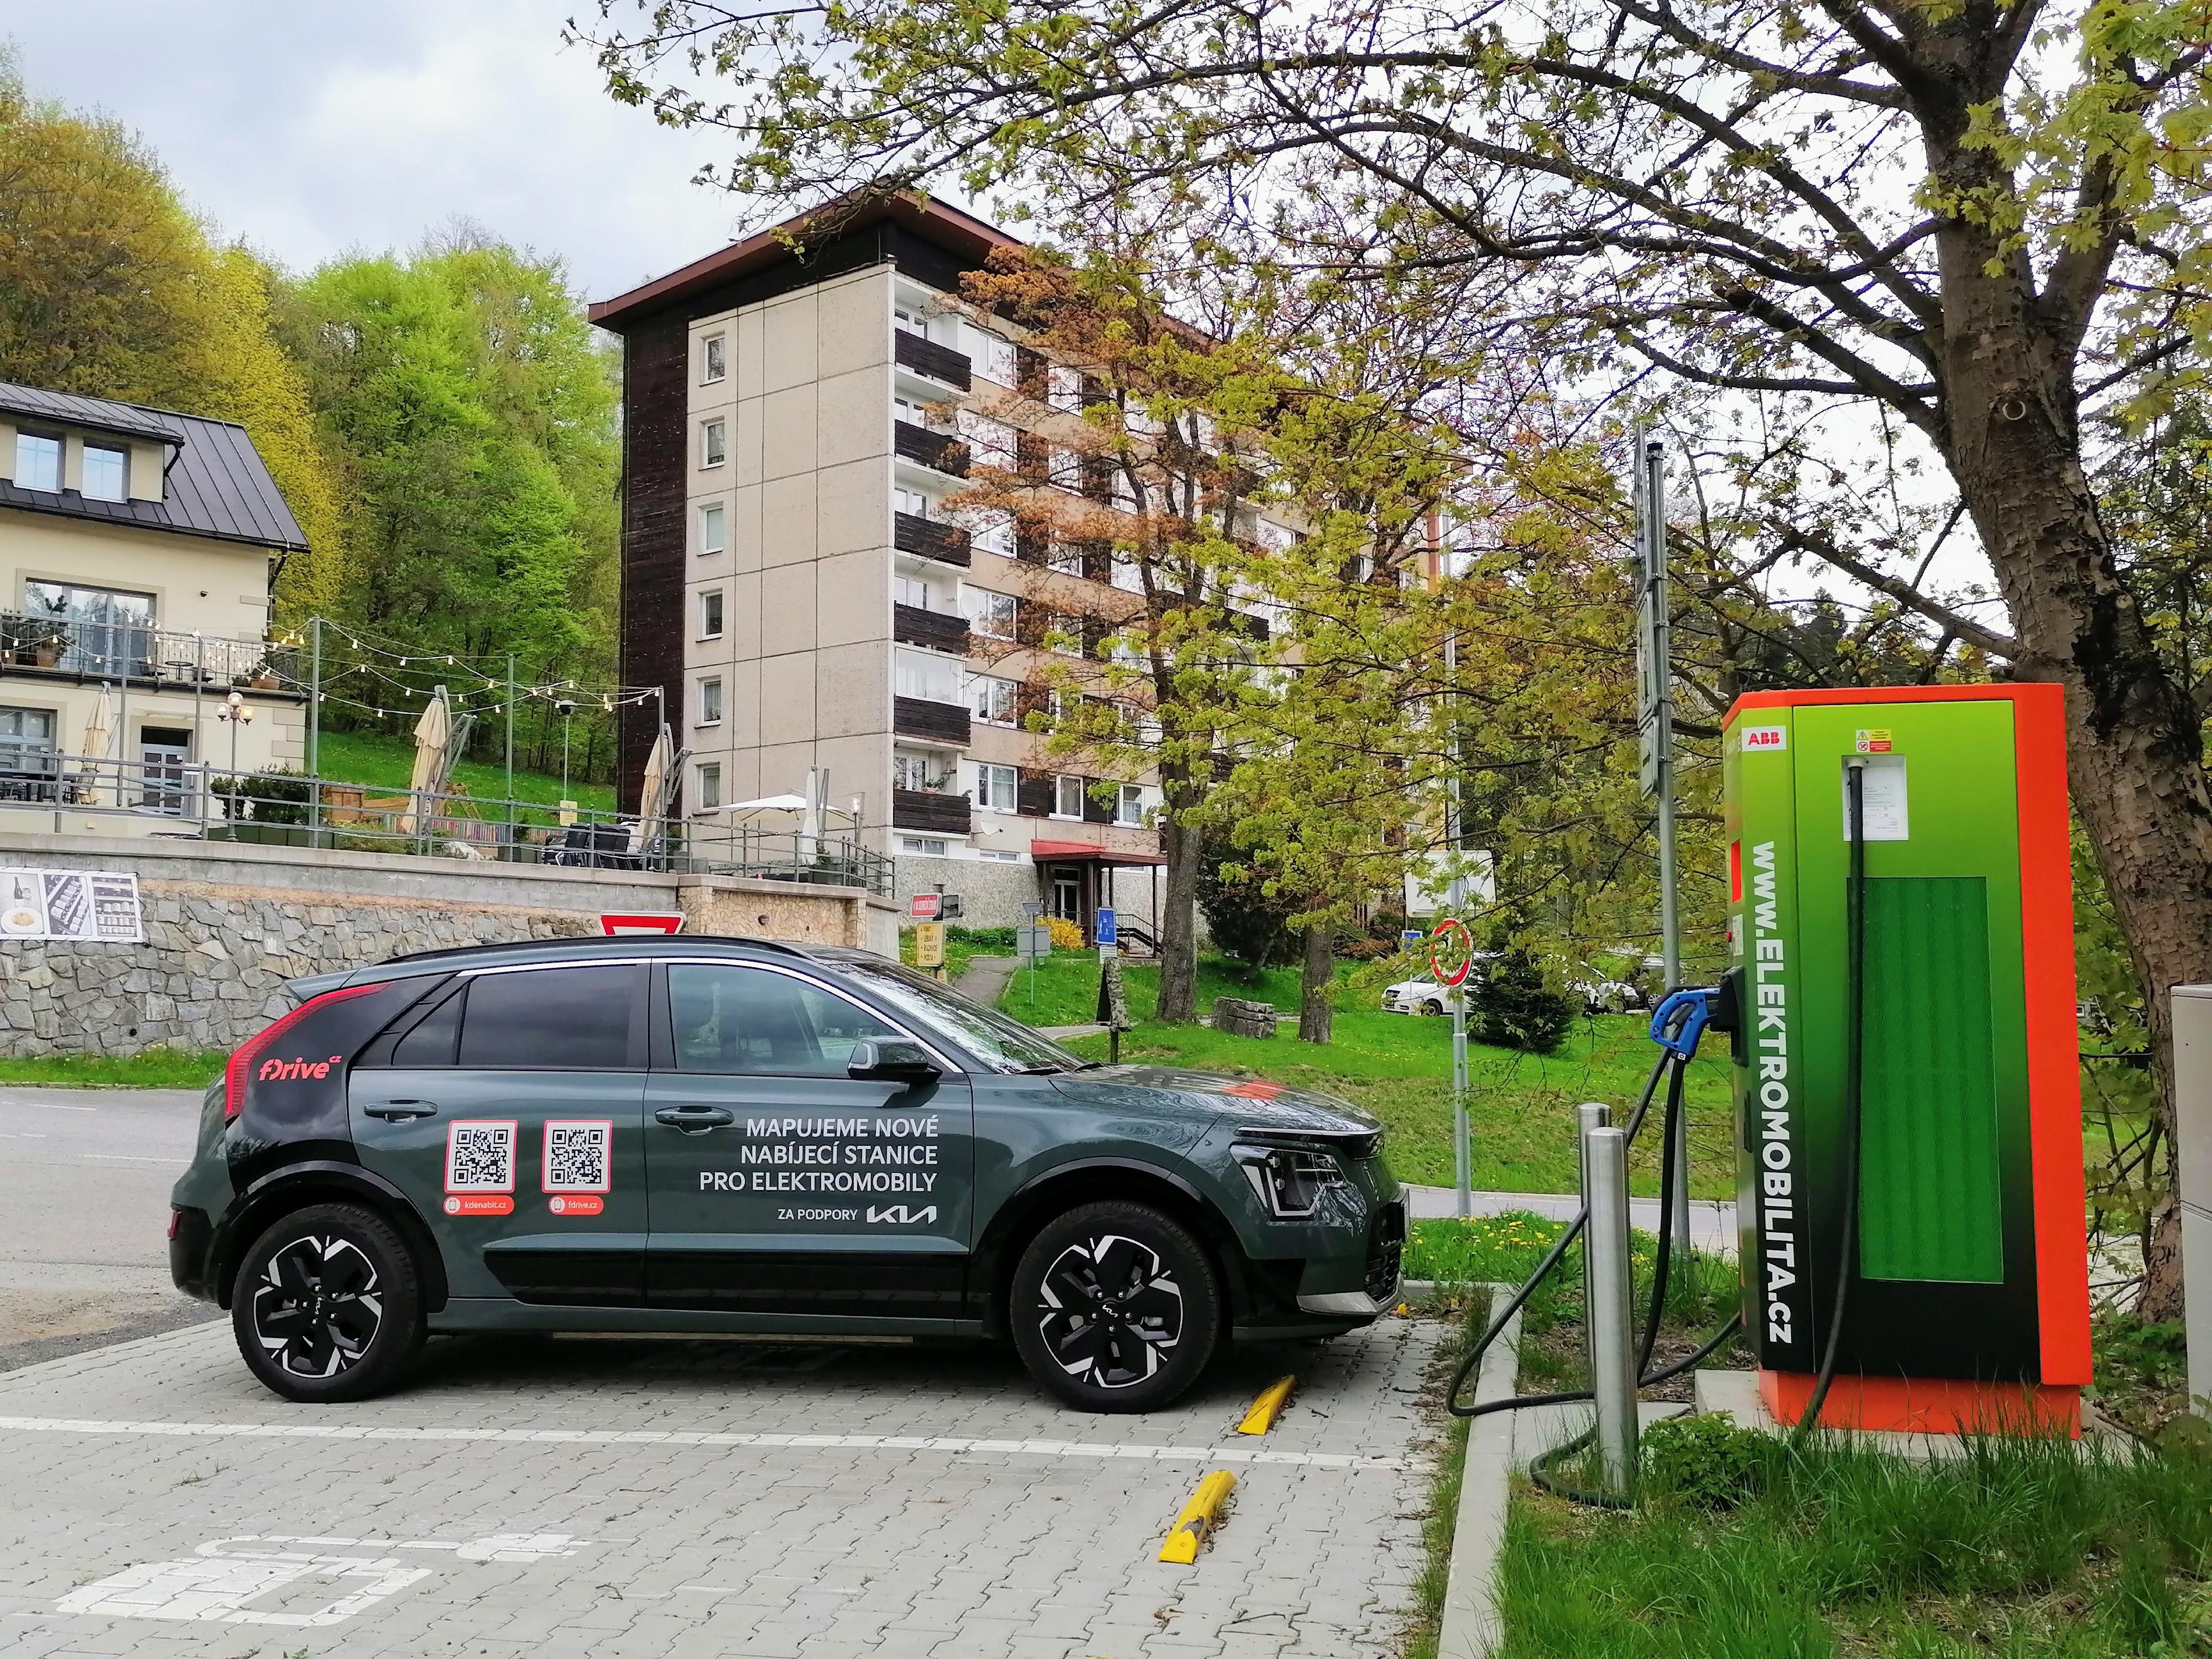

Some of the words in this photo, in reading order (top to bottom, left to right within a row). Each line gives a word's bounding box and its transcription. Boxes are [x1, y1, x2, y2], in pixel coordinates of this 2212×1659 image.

[1748, 732, 1780, 745] ABB
[746, 1118, 869, 1138] MAPUJEME
[875, 1114, 939, 1138] NOVÉ
[741, 1141, 839, 1165] NABÍJECÍ
[844, 1145, 938, 1165] STANICE
[699, 1172, 745, 1191] PRO
[752, 1172, 938, 1192] ELEKTROMOBILY
[778, 1209, 794, 1220] ZA
[797, 1208, 858, 1220] PODPORY
